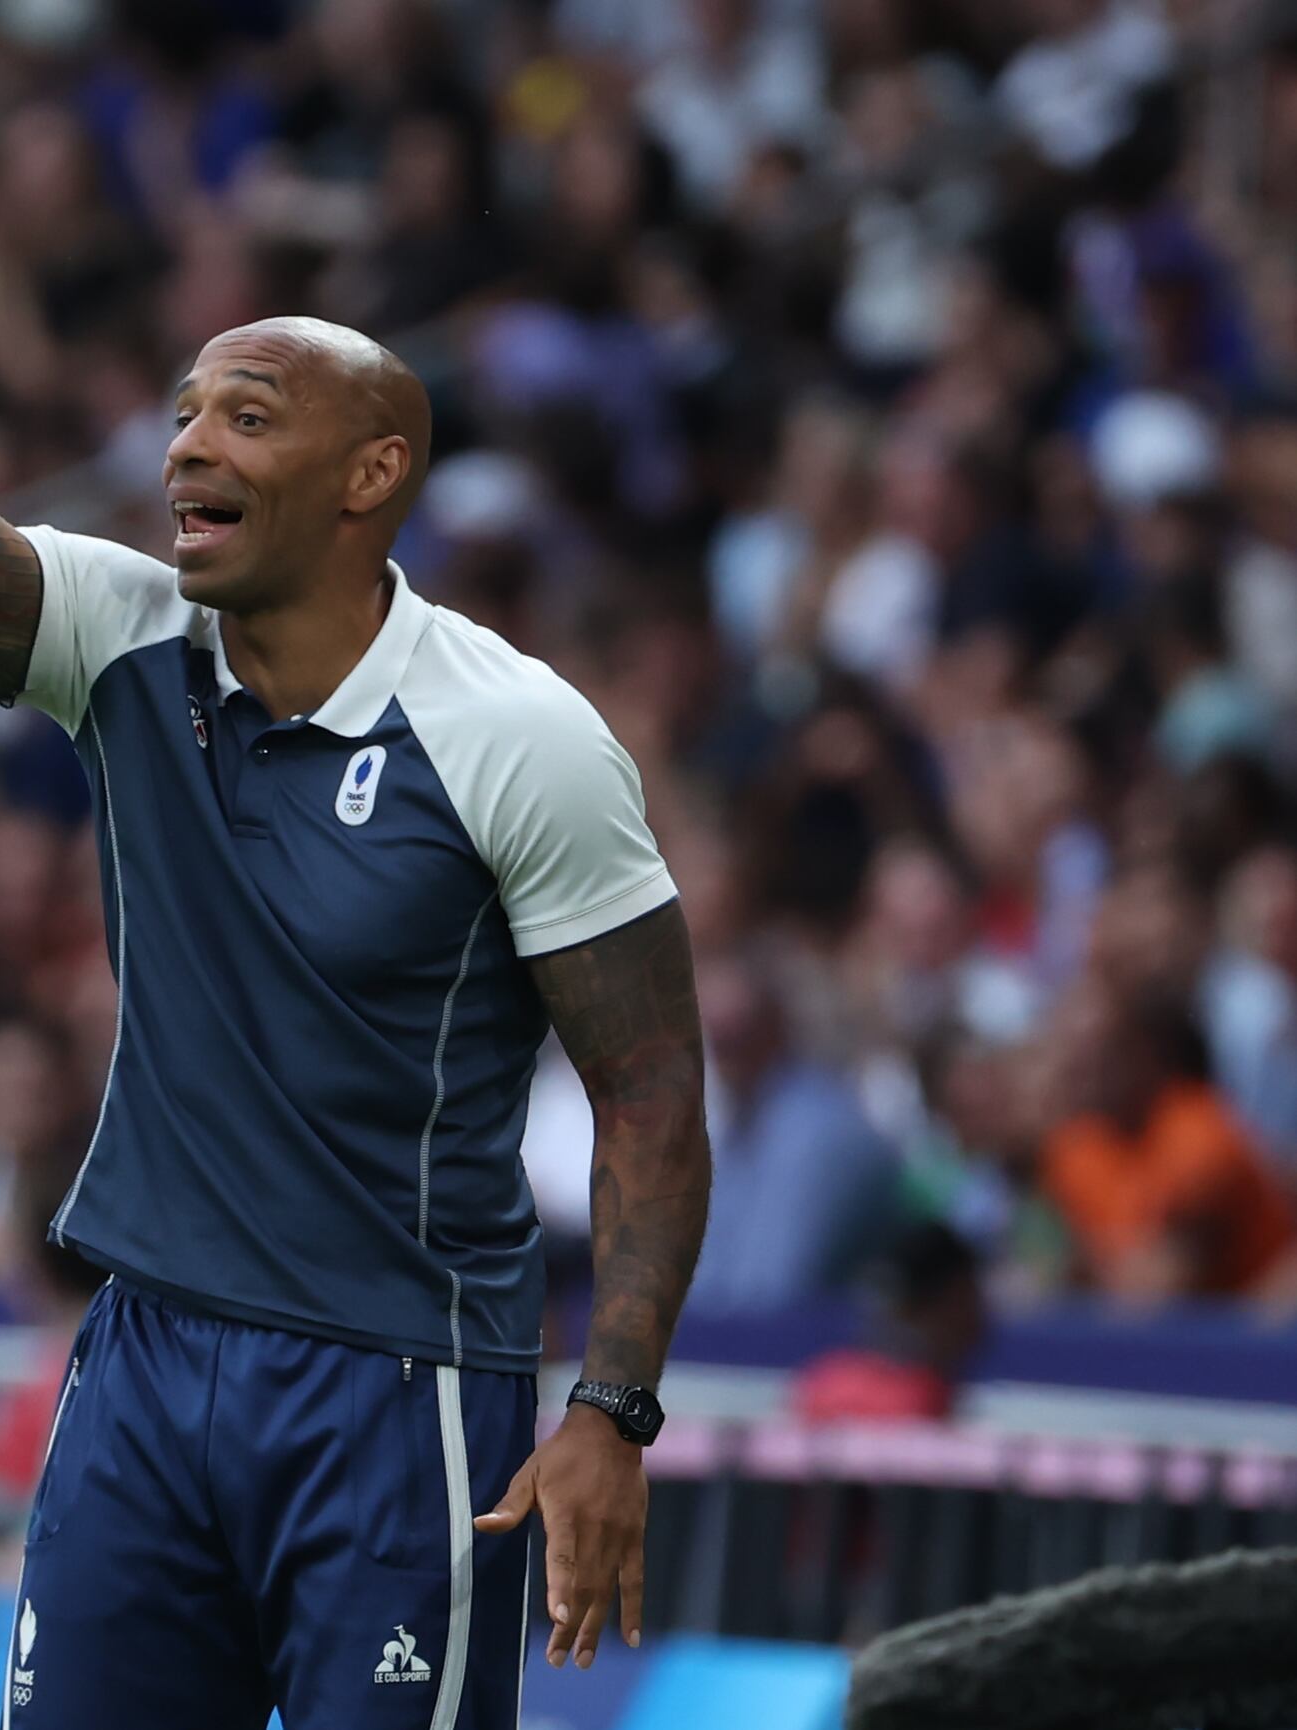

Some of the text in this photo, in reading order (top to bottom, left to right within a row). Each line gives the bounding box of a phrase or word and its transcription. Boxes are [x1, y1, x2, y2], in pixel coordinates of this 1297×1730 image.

[346, 792, 367, 801] FRANCE
[374, 1671, 431, 1683] LE COQ SPORTIF
